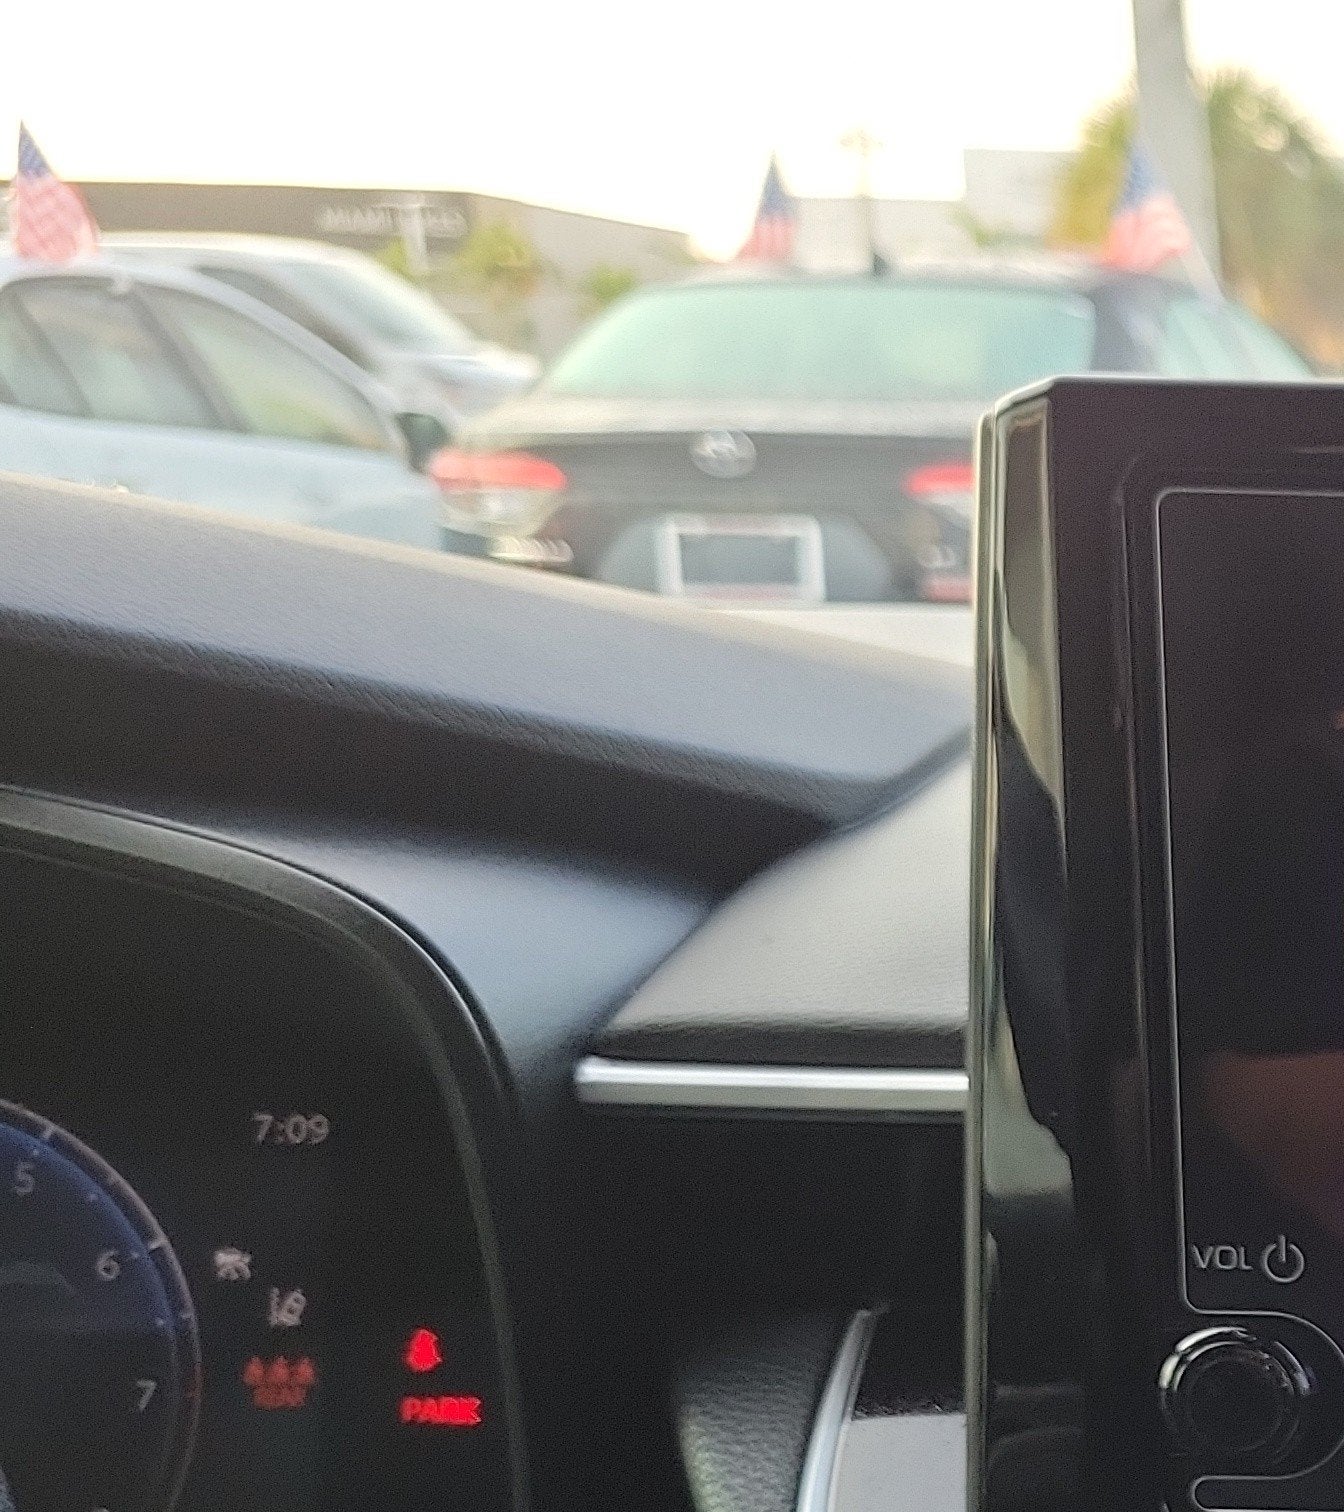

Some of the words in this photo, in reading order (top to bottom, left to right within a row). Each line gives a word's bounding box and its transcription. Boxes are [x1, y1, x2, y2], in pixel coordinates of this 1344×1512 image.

[254, 1113, 329, 1144] 7:09
[14, 1161, 36, 1196] 5
[96, 1250, 121, 1281] 6
[1192, 1245, 1252, 1270] VOL
[136, 1379, 157, 1411] 7
